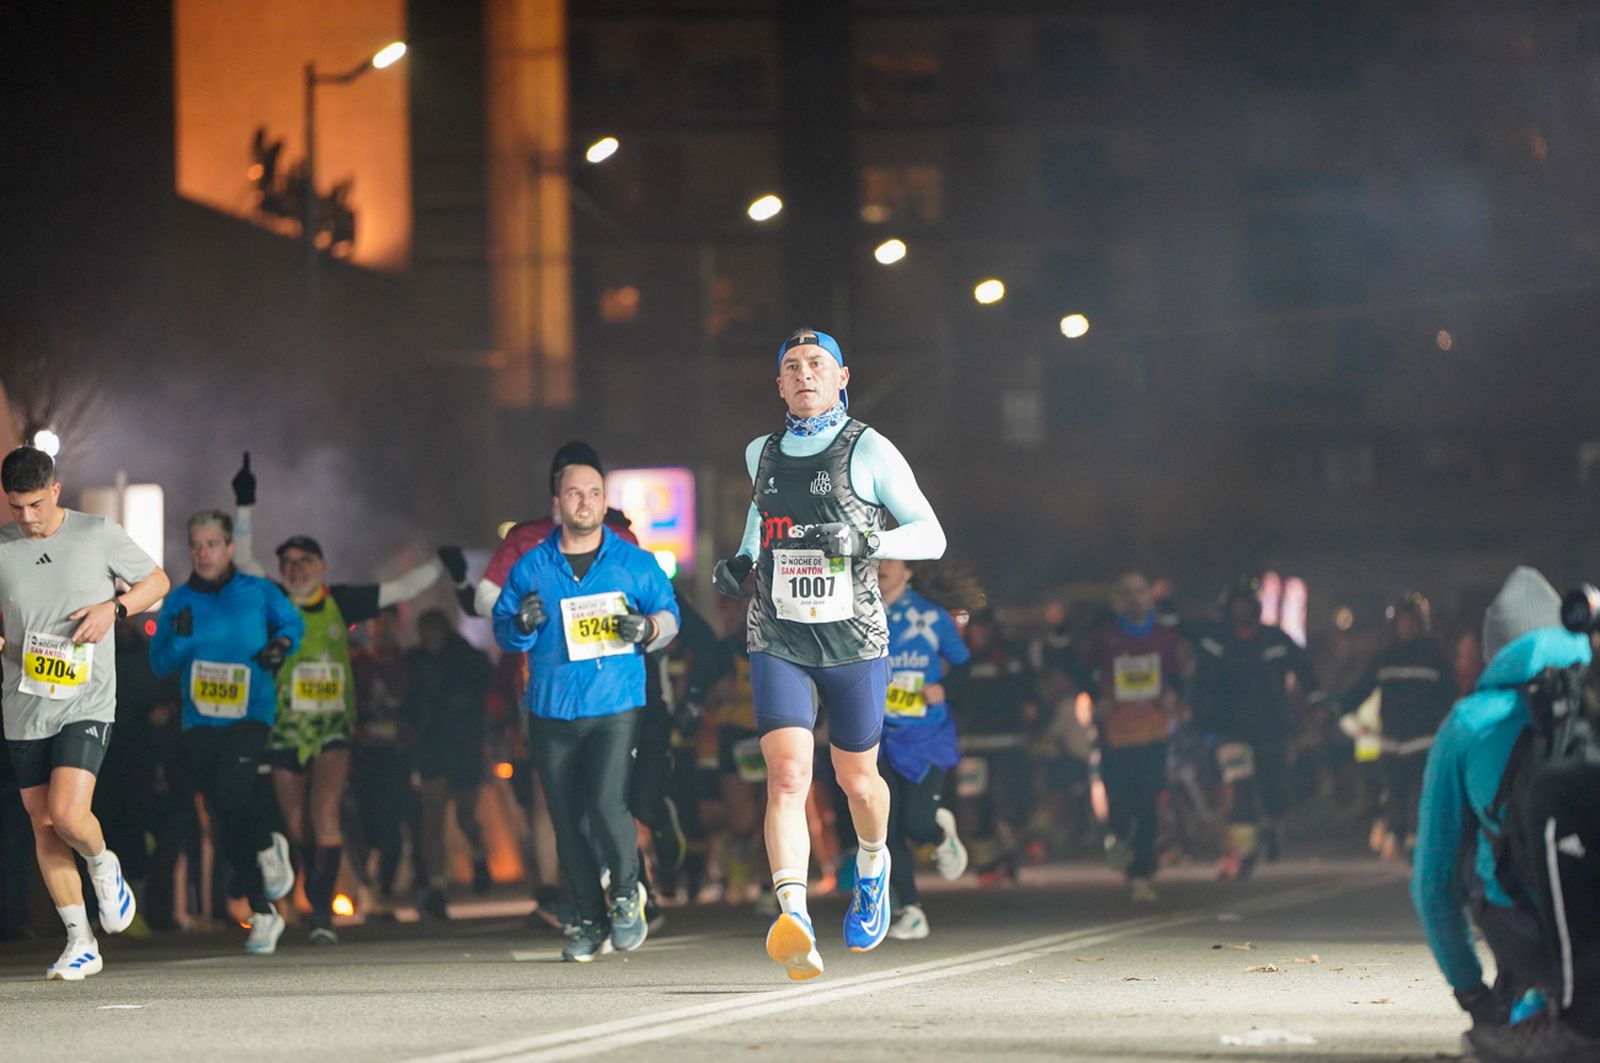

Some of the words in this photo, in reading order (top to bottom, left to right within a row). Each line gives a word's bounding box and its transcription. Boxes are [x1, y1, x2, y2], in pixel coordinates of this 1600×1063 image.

[781, 566, 795, 575] SAN
[796, 565, 823, 575] ANTÓN
[788, 576, 836, 598] 1007
[31, 646, 44, 655] SAN
[35, 655, 76, 680] 3704
[200, 679, 238, 699] 2359
